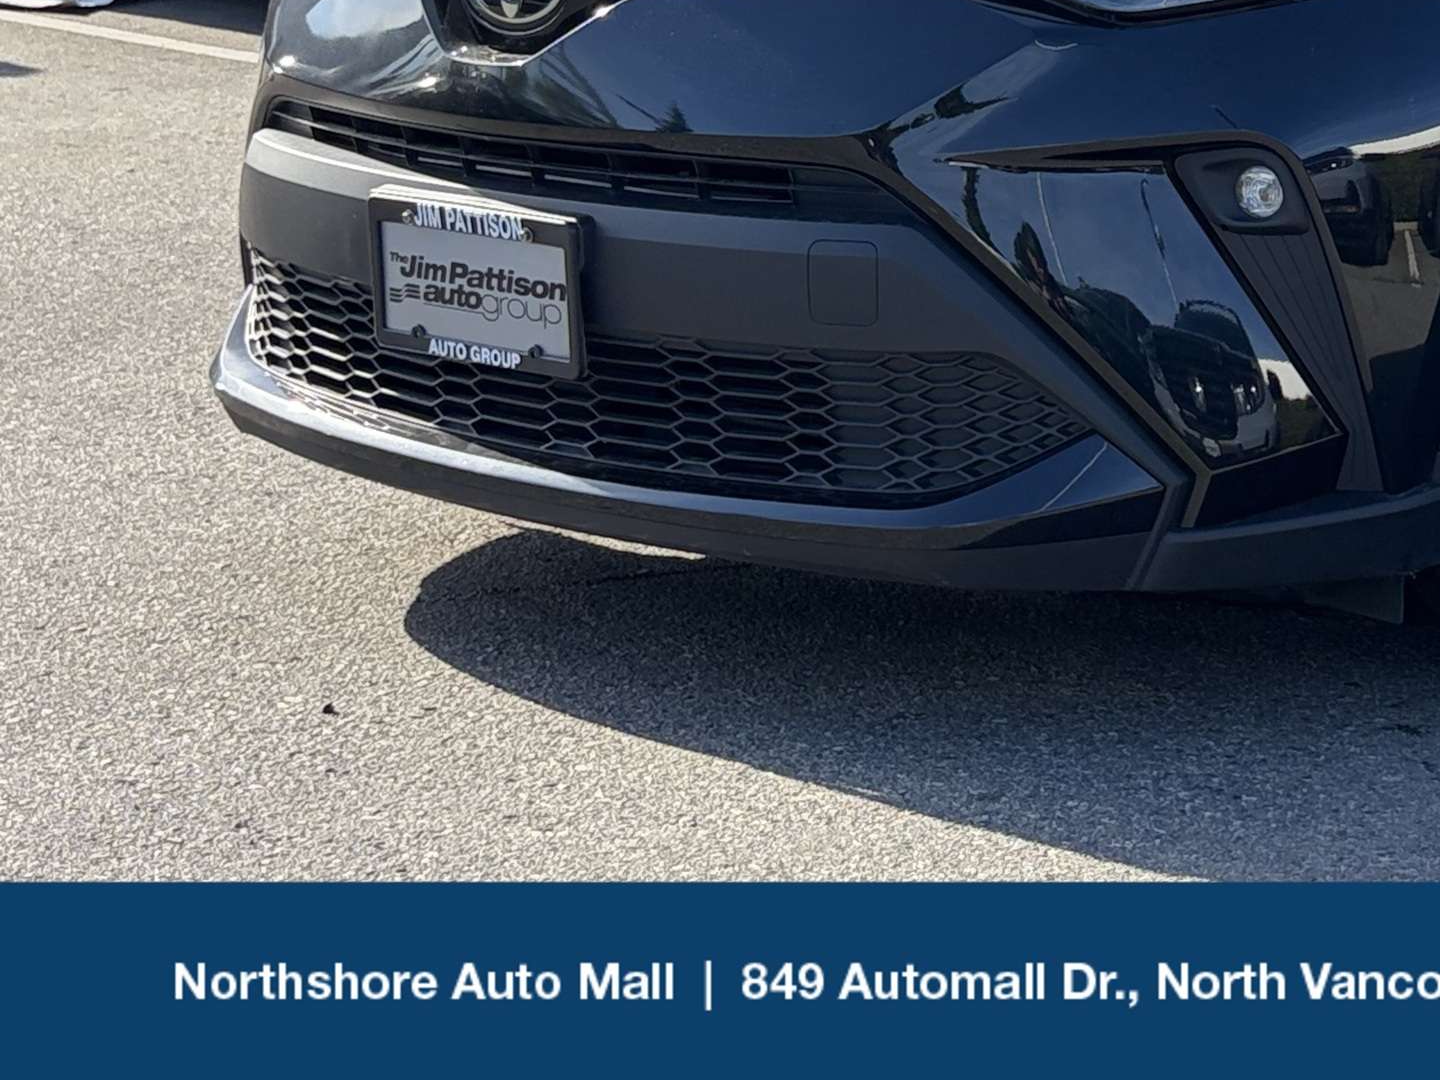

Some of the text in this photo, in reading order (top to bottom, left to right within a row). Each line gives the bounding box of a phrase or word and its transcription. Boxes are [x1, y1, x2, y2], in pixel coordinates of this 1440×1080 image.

[415, 202, 523, 241] JIM PATTISON
[389, 251, 408, 265] The
[428, 337, 522, 369] AUTO GROUP
